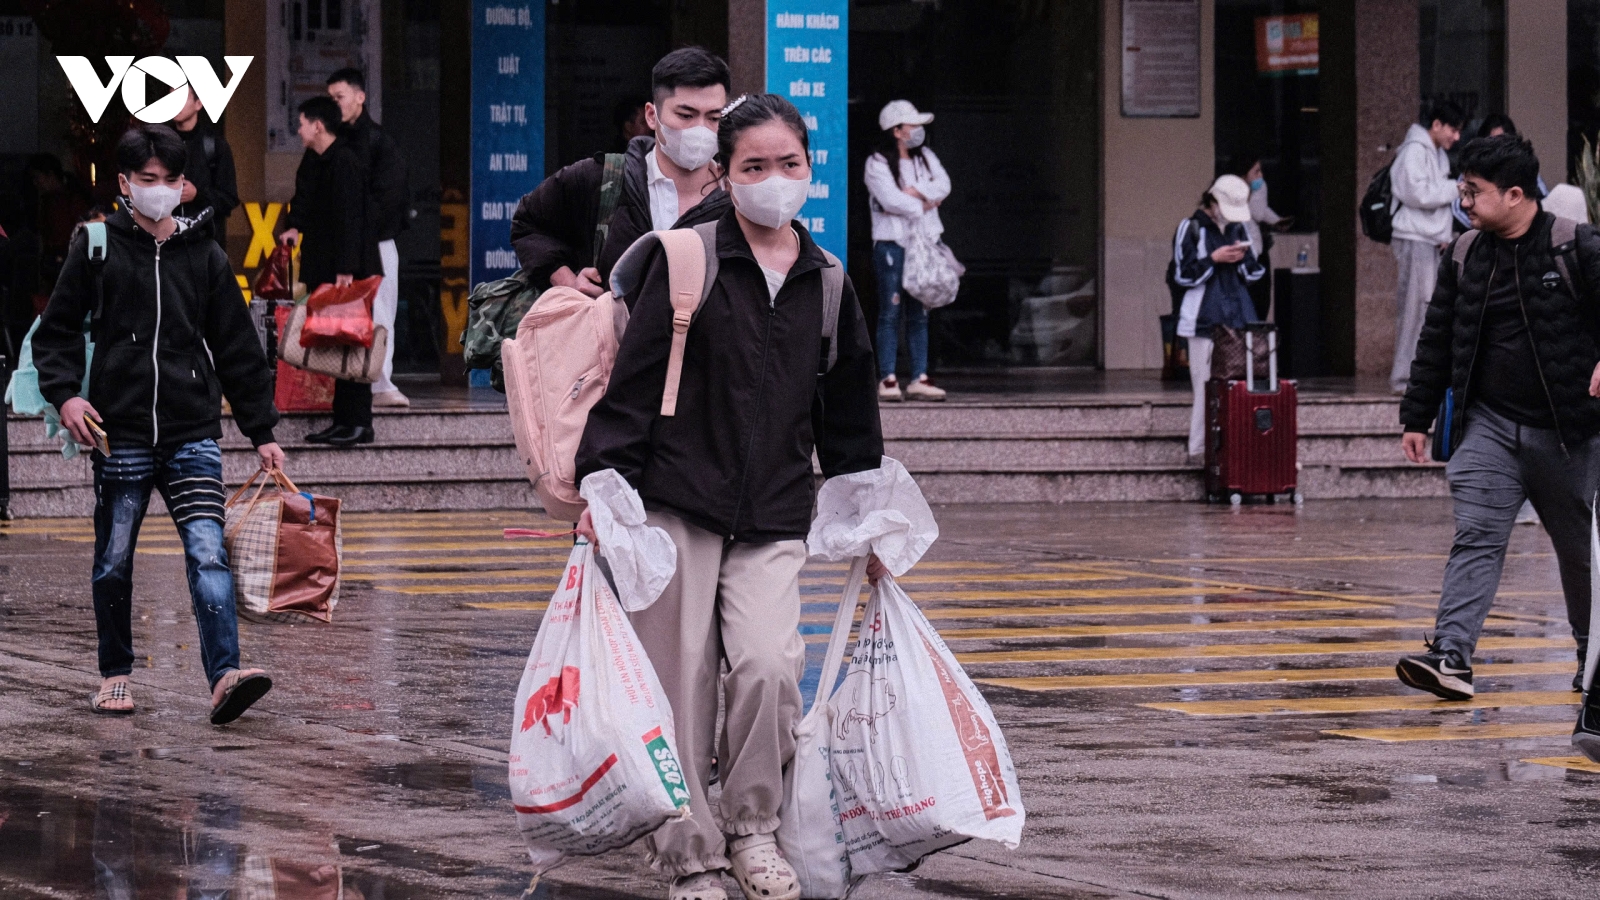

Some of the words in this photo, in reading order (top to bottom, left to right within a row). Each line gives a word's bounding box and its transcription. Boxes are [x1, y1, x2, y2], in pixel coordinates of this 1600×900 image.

[776, 11, 804, 29] HÀNH
[806, 12, 840, 30] KHÁCH
[784, 45, 810, 63] TRÊN
[811, 46, 832, 64] CÁC
[498, 53, 520, 78] LUẬT
[789, 78, 811, 97] BẾN
[812, 82, 826, 98] XE
[490, 102, 512, 127] TRẬT
[490, 154, 502, 171] AN
[504, 150, 528, 172] TOÀN
[808, 179, 830, 198] HẦN
[482, 202, 503, 220] GIAO
[811, 217, 825, 233] XE
[485, 246, 516, 269] ĐƯỜNG
